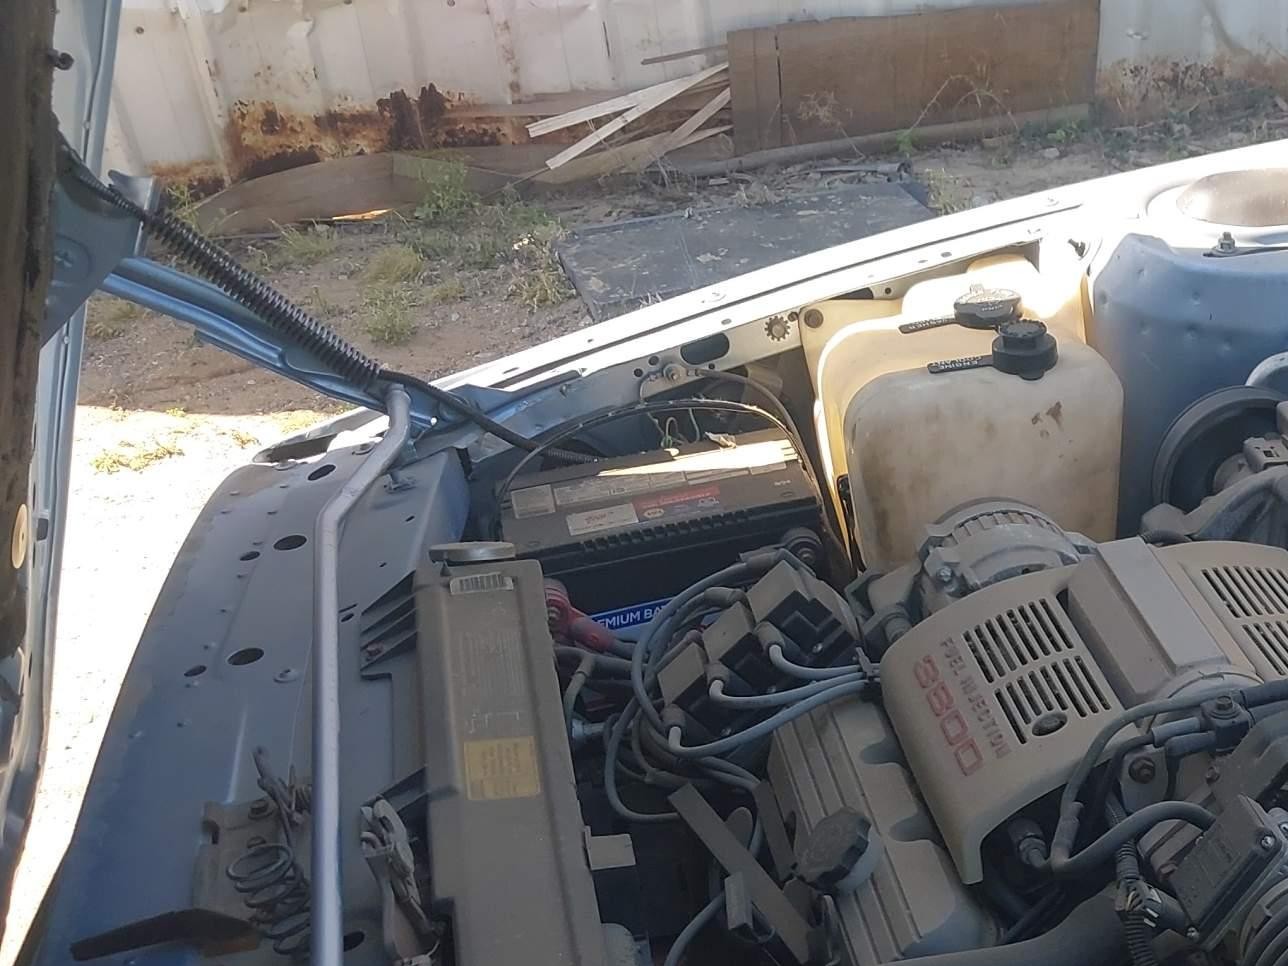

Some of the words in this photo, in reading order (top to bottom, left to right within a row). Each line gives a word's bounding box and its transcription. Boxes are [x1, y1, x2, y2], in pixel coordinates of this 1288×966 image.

[597, 609, 641, 629] EMIUM
[643, 605, 664, 620] BA
[913, 654, 984, 777] 3800
[940, 636, 966, 677] FUEL
[960, 675, 1013, 760] INJECTION
